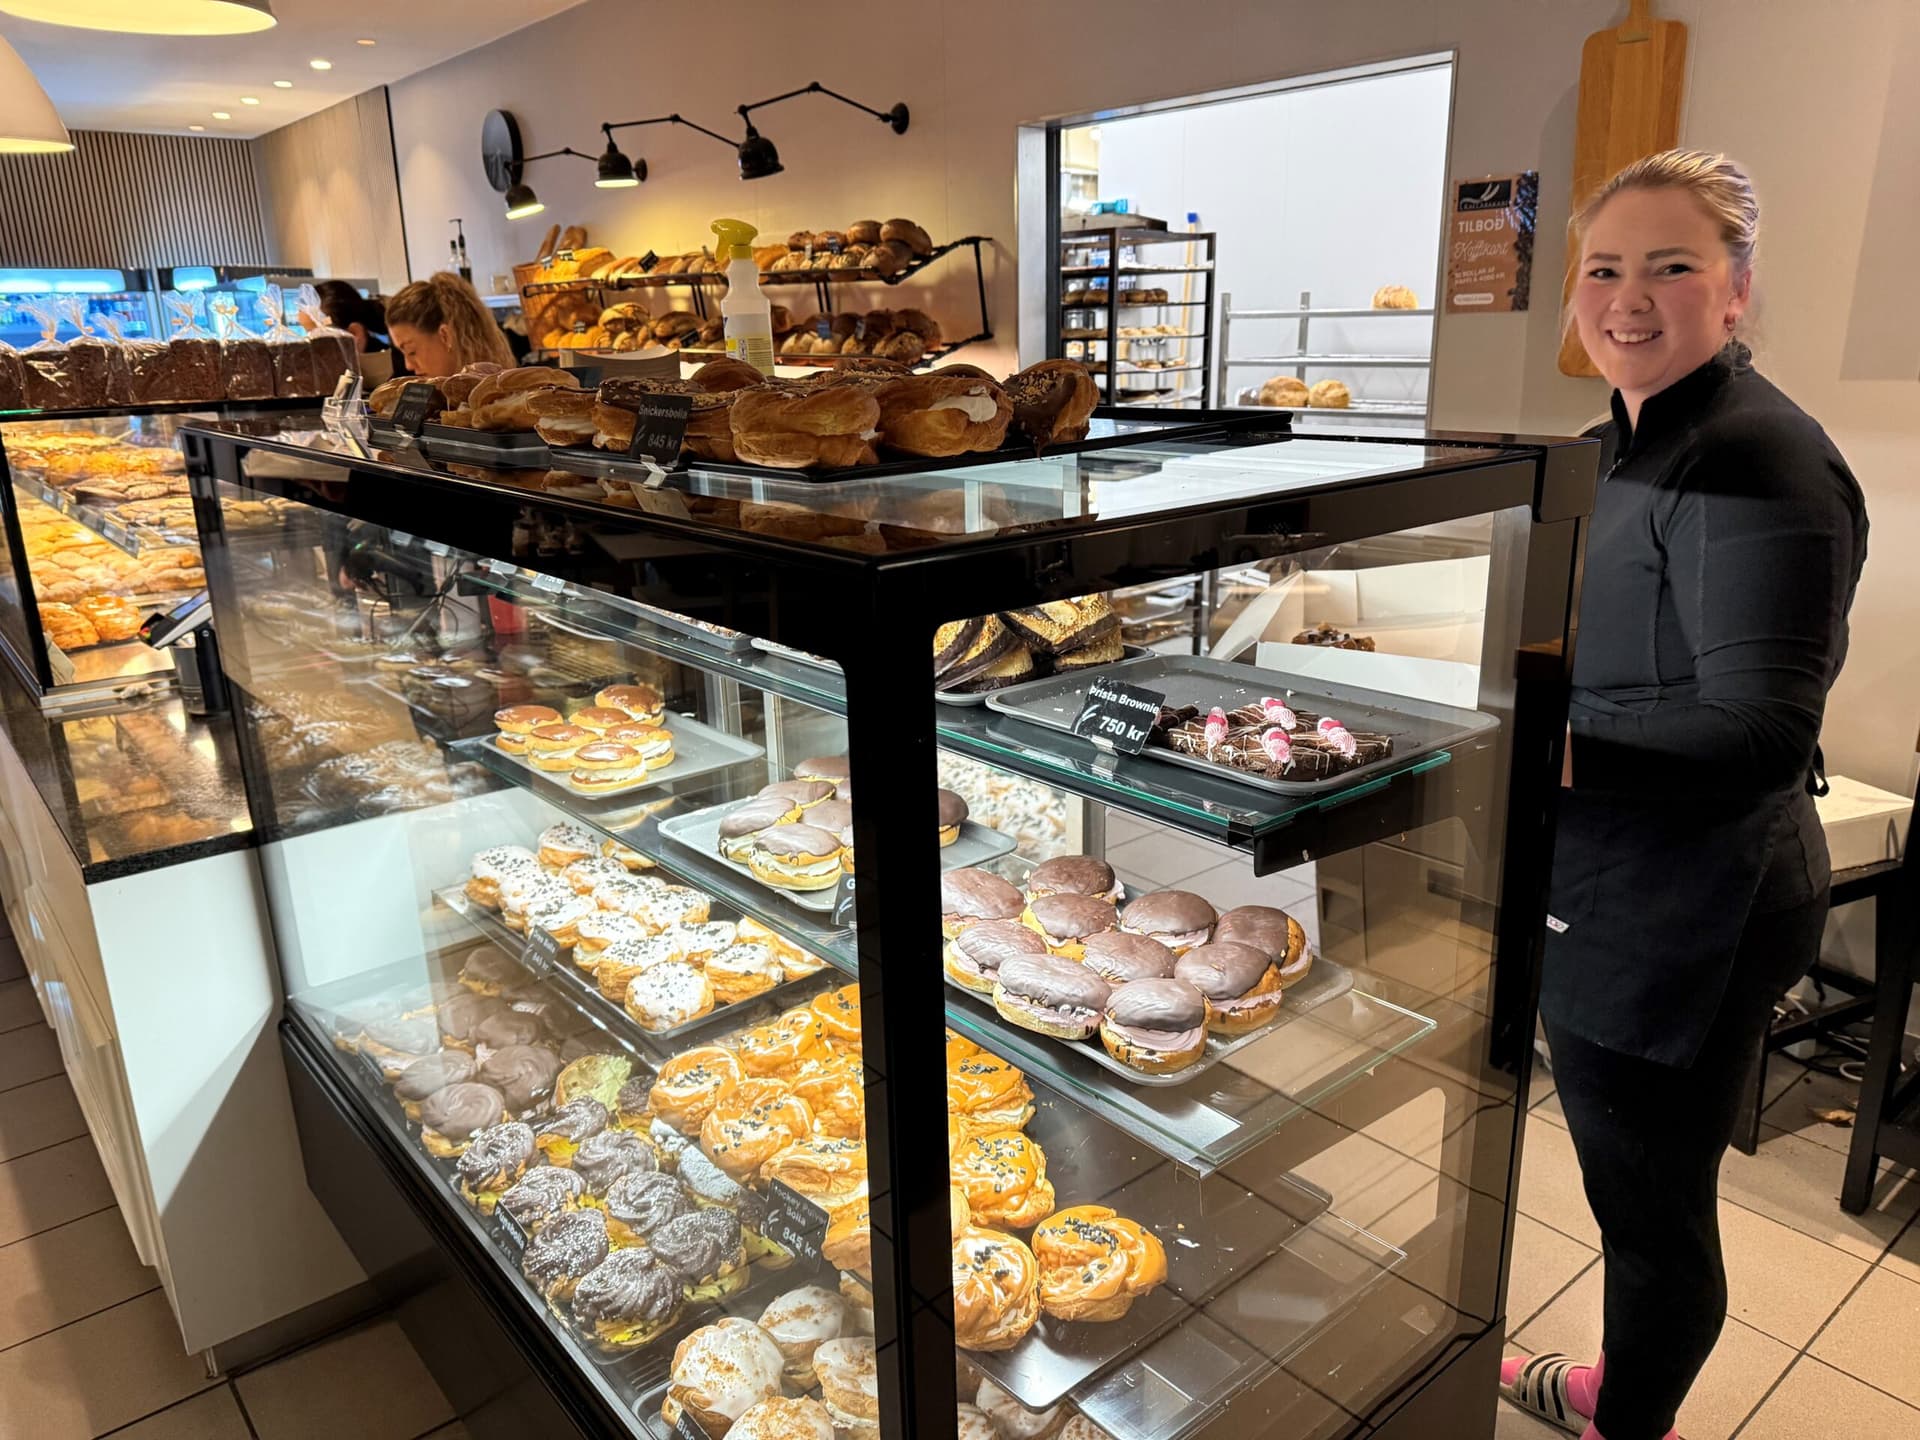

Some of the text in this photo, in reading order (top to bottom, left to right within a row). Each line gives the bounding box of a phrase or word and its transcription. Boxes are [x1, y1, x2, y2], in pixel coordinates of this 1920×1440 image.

[1118, 693, 1161, 715] Brownie
[1099, 715, 1146, 742] 750 kr
[782, 1226, 818, 1259] 845 kr
